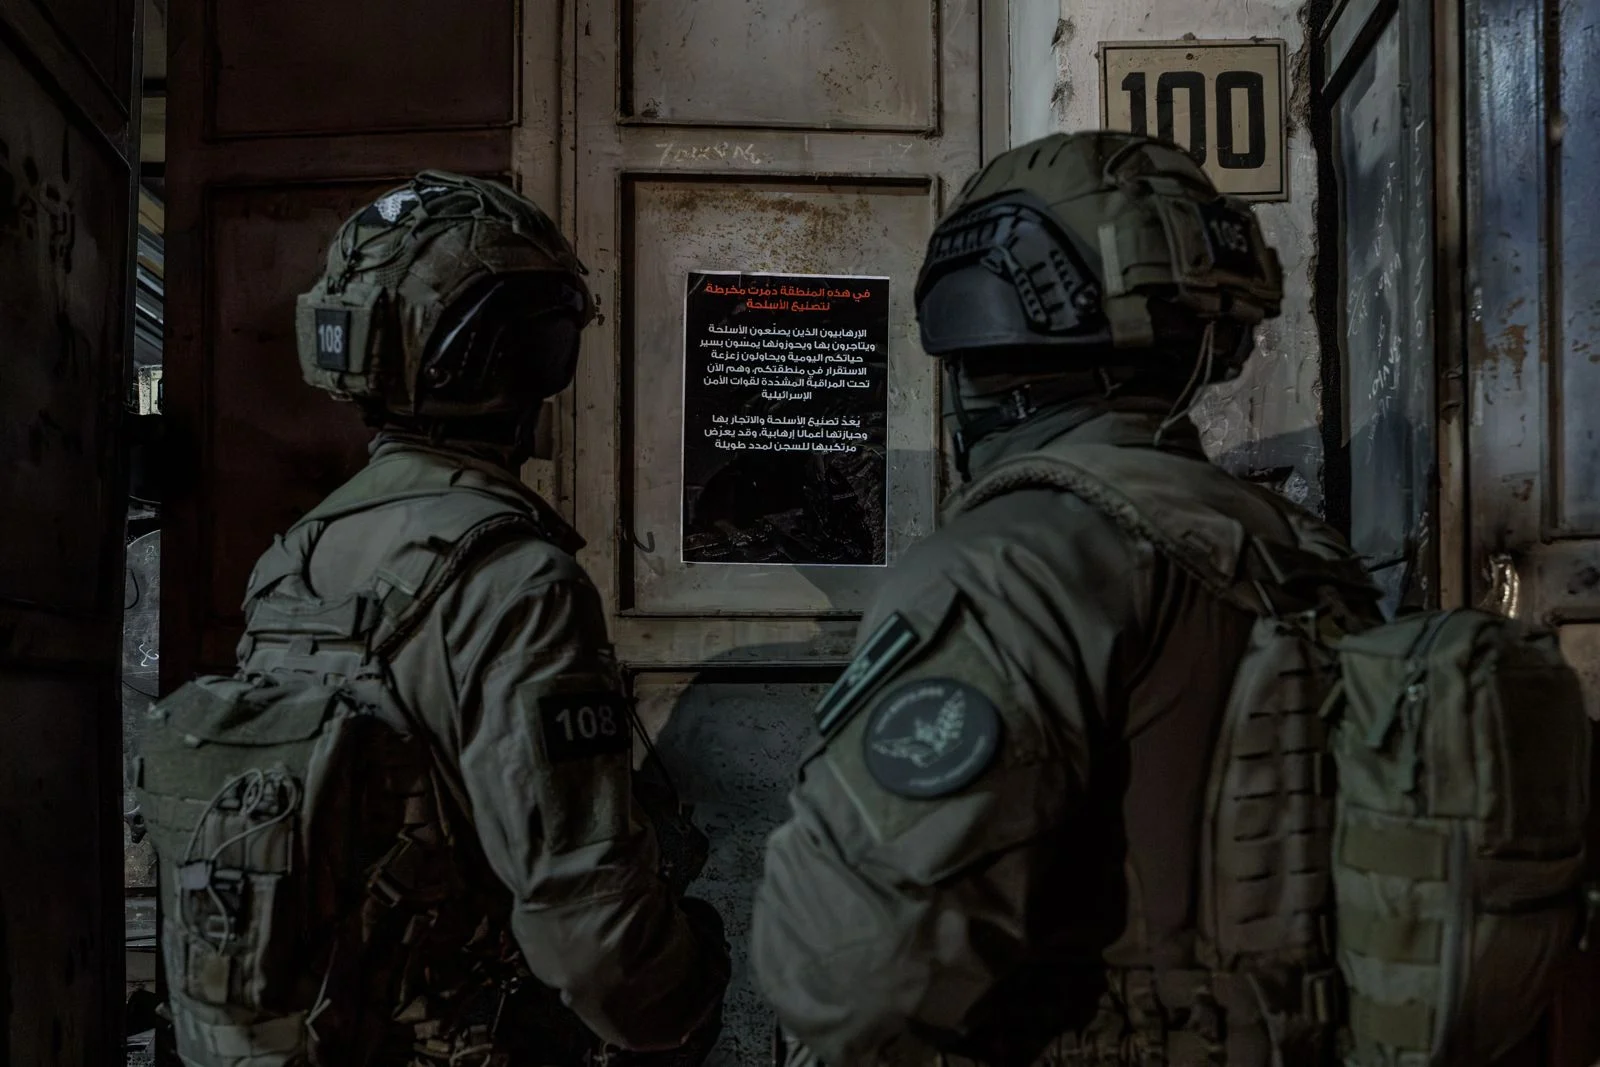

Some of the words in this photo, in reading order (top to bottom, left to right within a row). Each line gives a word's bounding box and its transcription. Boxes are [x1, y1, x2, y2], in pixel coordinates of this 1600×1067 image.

[1122, 70, 1266, 169] 100
[706, 283, 746, 295] مخرطة
[780, 286, 825, 297] المنطقة
[827, 288, 850, 298] هذه
[852, 291, 871, 302] في
[746, 299, 789, 310] الأسلحة
[791, 301, 830, 311] لتصنيع
[708, 324, 748, 334] الأسلحة
[792, 328, 818, 337] الذين
[820, 329, 867, 339] الإرهابيون
[318, 323, 344, 354] 108
[700, 340, 723, 348] بسير
[762, 340, 812, 350] ويحوزونها
[814, 341, 830, 350] بها
[832, 341, 876, 351] ويتاجرون
[711, 350, 740, 361] زعزعة
[741, 352, 786, 362] ويحاولون
[788, 352, 823, 362] اليومية
[825, 353, 863, 363] حياتكم
[707, 363, 723, 373] الآن
[726, 365, 750, 374] وهم
[807, 368, 823, 377] في
[825, 367, 867, 376] الاستقرار
[703, 376, 728, 386] الأمن
[730, 377, 759, 387] لقوات
[807, 377, 845, 388] المراقبة
[847, 380, 870, 388] تحت
[761, 389, 812, 401] الإسرائيلية
[712, 415, 728, 424] بها
[731, 415, 764, 425] والاتجار
[767, 415, 805, 425] الأسلحة
[808, 416, 839, 427] تصنيع
[738, 428, 757, 438] وقد
[826, 429, 868, 440] وحيازتها
[715, 439, 746, 449] طويلة
[748, 441, 772, 450] لمدد
[774, 442, 810, 451] للسجن
[812, 442, 857, 452] مرتكبيها
[555, 705, 618, 742] 108
